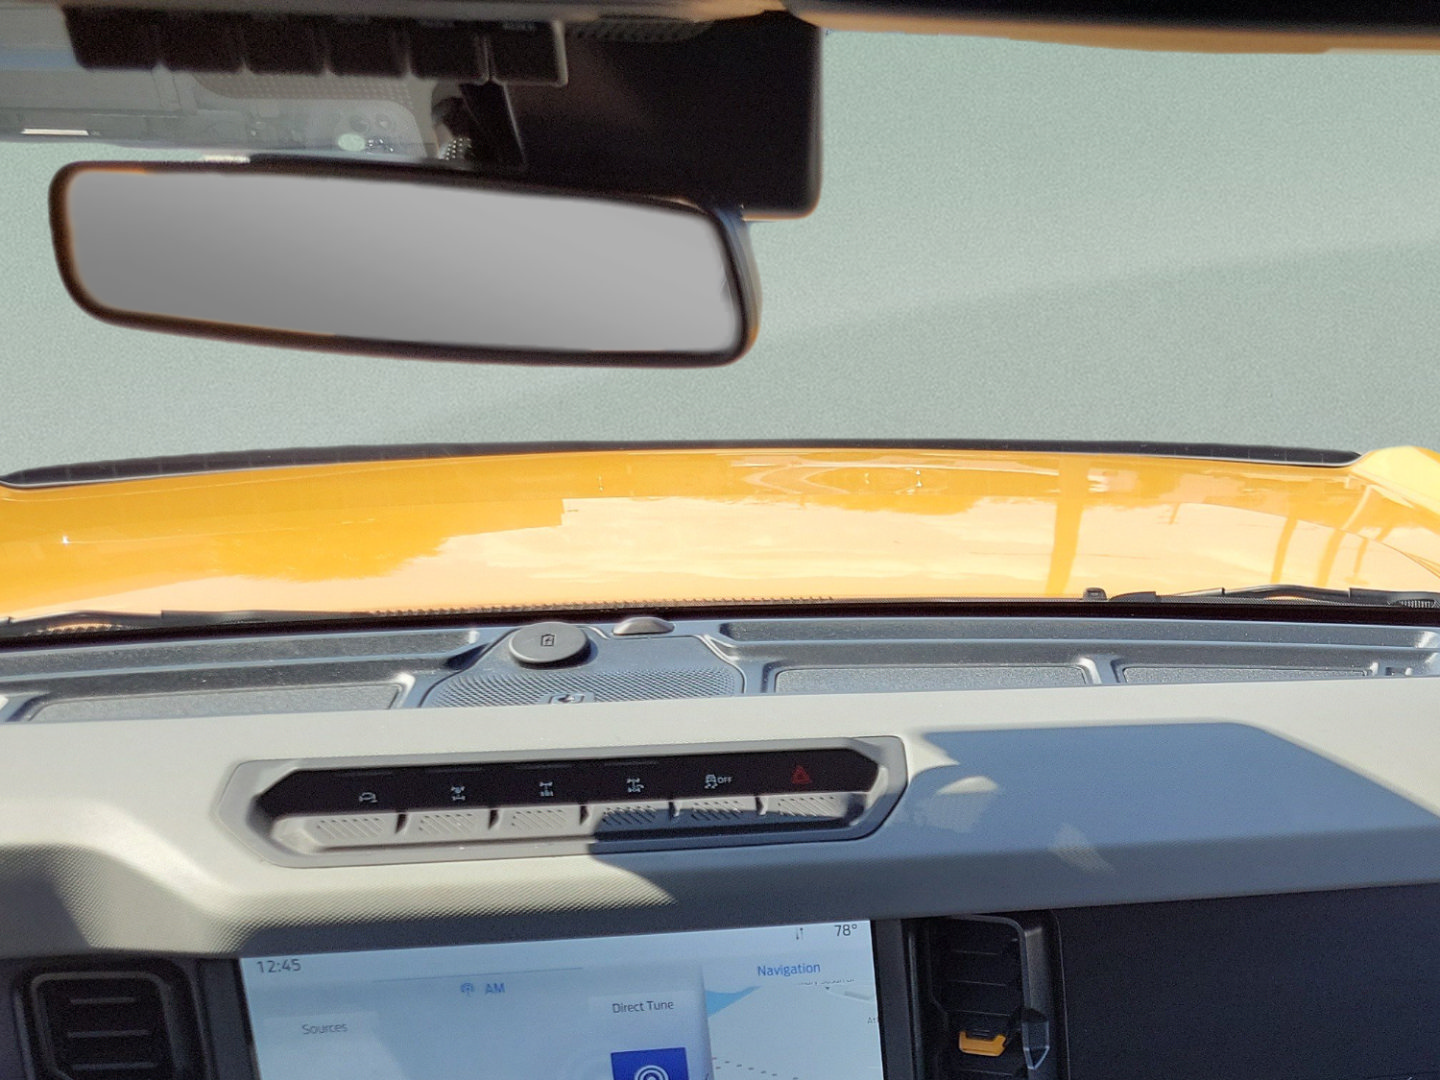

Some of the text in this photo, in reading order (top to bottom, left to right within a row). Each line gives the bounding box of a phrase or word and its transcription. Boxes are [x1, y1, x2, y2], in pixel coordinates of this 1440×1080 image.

[717, 776, 732, 784] OFF
[257, 958, 302, 974] 12:45
[757, 962, 821, 978] Navigation
[484, 982, 506, 995] AM
[612, 1000, 675, 1014] Direct Tune
[301, 1022, 349, 1035] Sources
